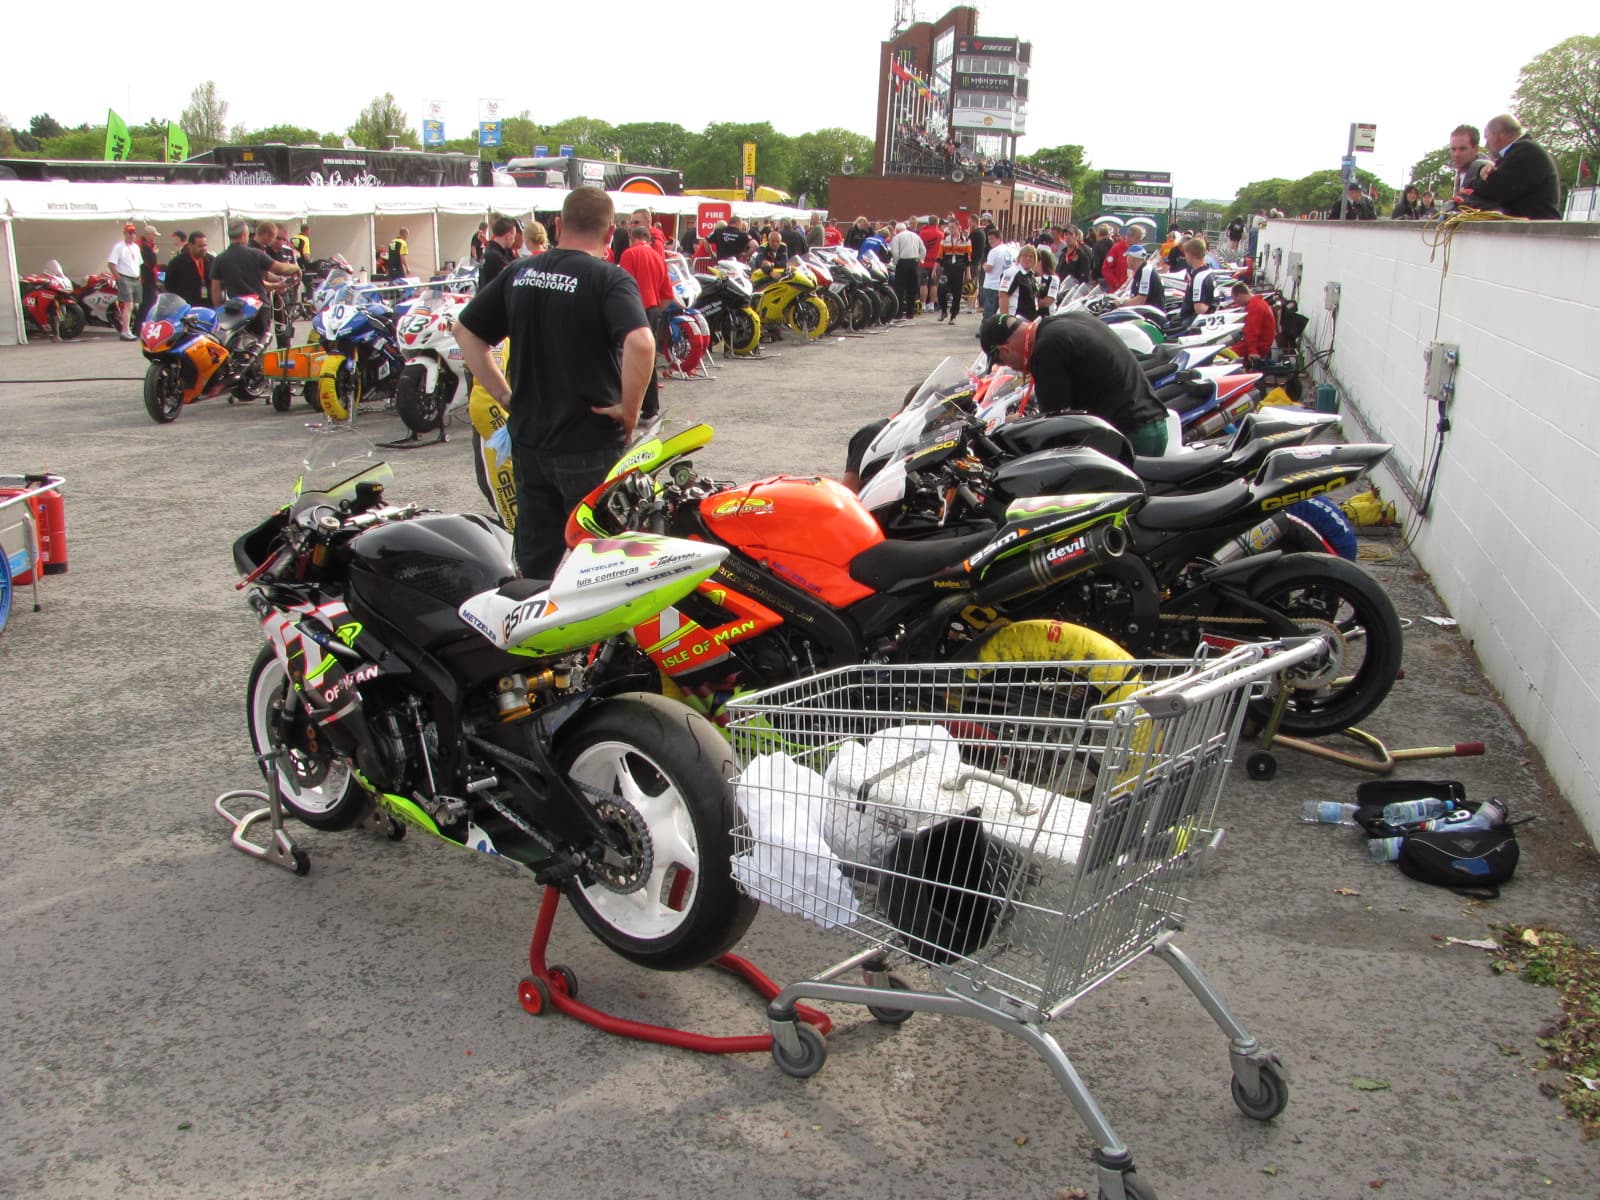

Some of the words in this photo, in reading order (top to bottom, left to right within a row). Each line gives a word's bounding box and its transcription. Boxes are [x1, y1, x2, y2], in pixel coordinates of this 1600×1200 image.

[705, 211, 724, 219] FIRE
[1261, 476, 1347, 511] GEICO
[1046, 536, 1086, 561] devil
[577, 577, 592, 588] luis
[595, 566, 640, 582] contreras
[625, 565, 693, 588] METZELER
[462, 609, 497, 642] METZELER
[662, 650, 690, 668] ISLE
[692, 640, 711, 655] OF
[713, 620, 755, 646] MAN
[325, 685, 340, 702] OF
